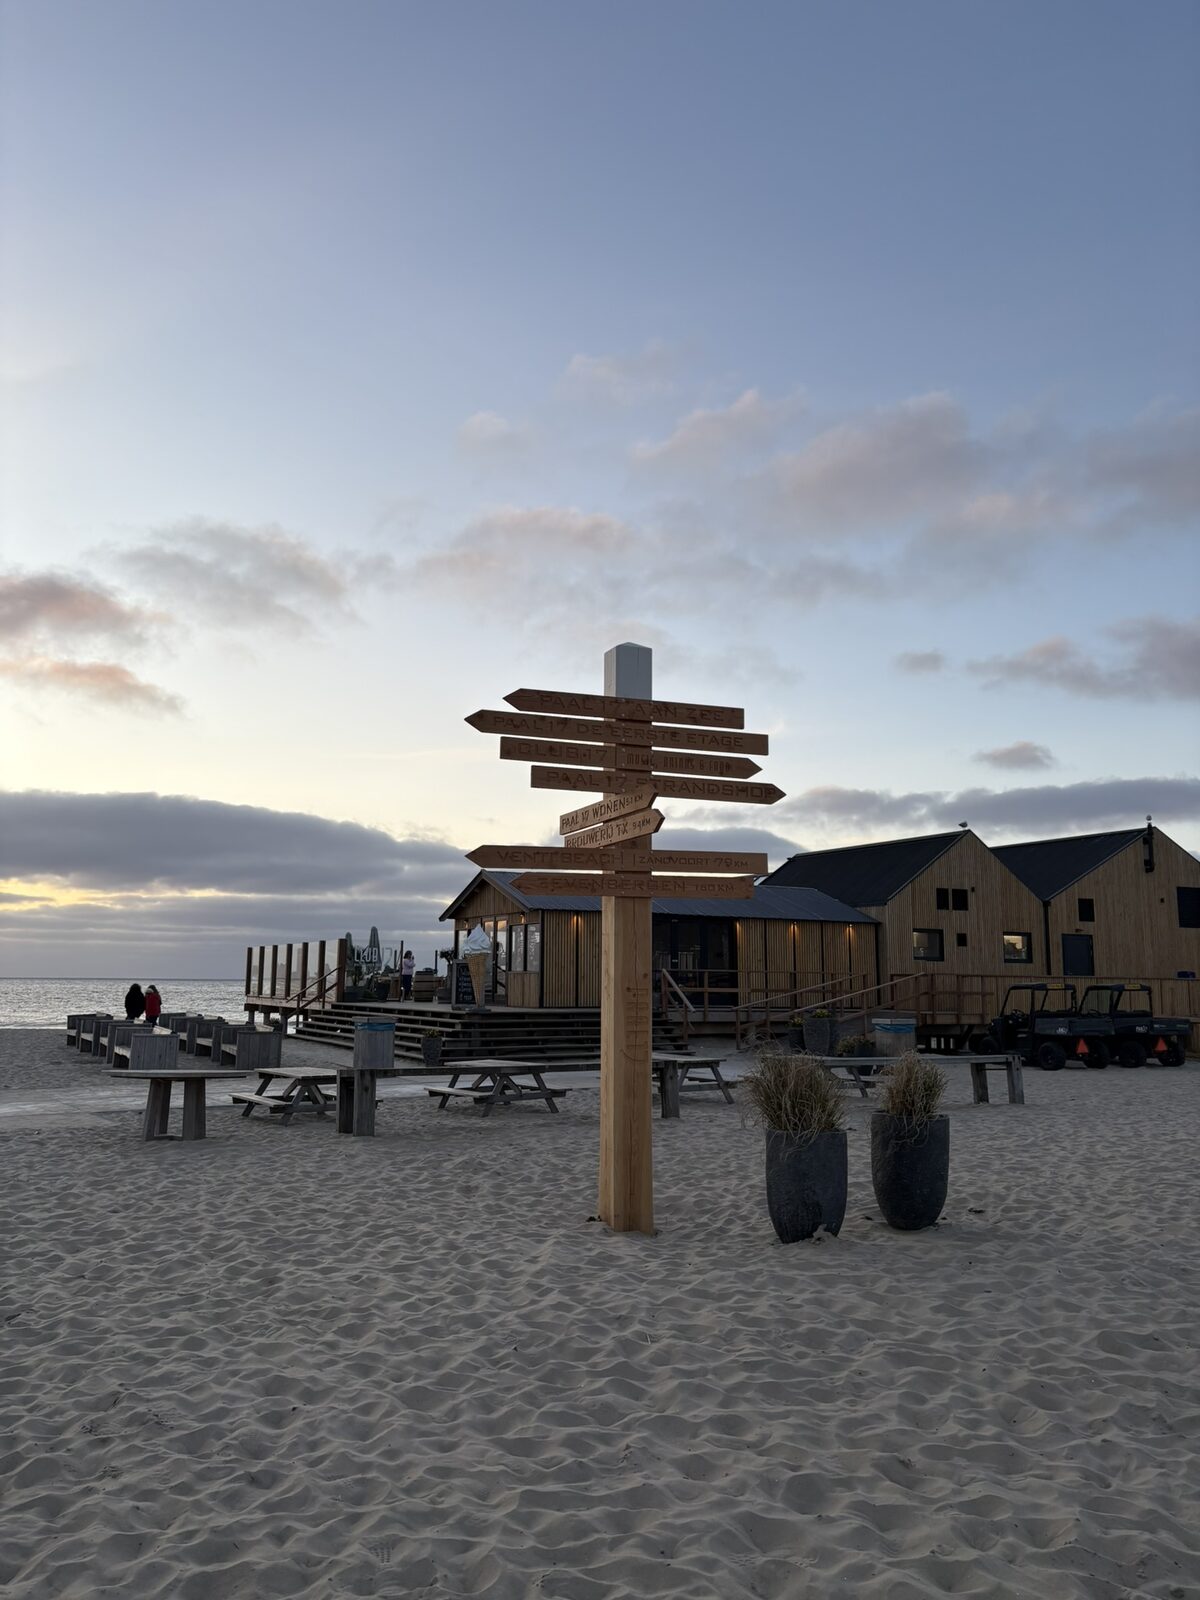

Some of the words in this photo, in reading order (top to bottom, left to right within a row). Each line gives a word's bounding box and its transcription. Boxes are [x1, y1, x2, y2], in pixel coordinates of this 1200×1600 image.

[540, 695, 593, 710] PAAL
[601, 699, 624, 714] 17
[635, 703, 677, 718] AAN
[687, 706, 724, 721] ZEE
[493, 716, 544, 731] PAAL
[549, 720, 568, 733] 17
[577, 723, 602, 736] DE
[611, 726, 681, 743] EERSTE
[687, 733, 744, 747] ETAGE
[517, 743, 579, 759] CLUB
[545, 771, 600, 786] PAAL
[606, 775, 628, 789] 17
[636, 778, 777, 798] STRANDSHOP
[561, 813, 579, 830] PAAL
[581, 811, 590, 822] 17
[592, 797, 626, 818] WONEN
[566, 825, 614, 848] BROUWERIJ
[616, 822, 629, 835] TX
[496, 850, 557, 864] VENTI
[561, 851, 624, 865] BEACH
[639, 855, 711, 866] ZANDVOORT
